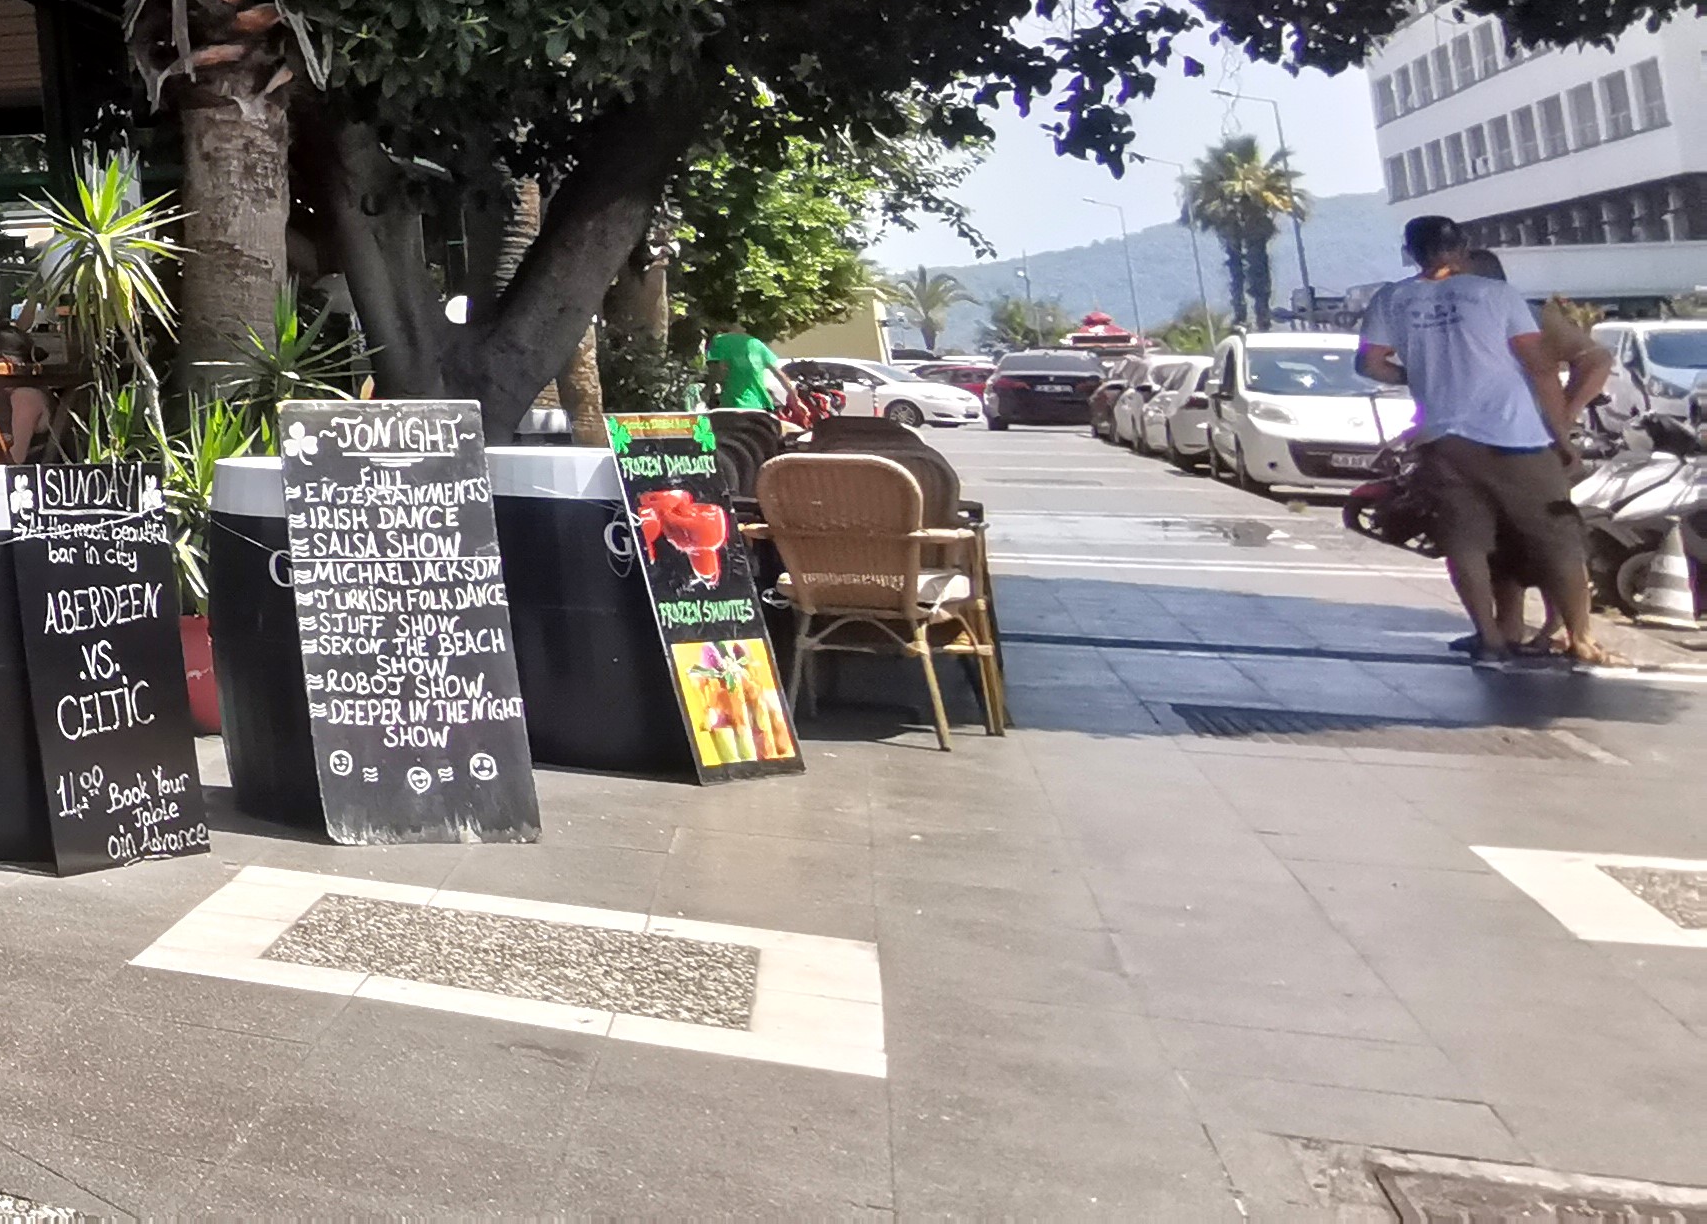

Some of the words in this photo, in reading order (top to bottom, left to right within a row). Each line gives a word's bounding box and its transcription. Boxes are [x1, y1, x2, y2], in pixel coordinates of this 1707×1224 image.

[45, 463, 135, 510] SUNDAY
[357, 466, 411, 490] FULL
[309, 506, 369, 530] IRISH
[377, 506, 460, 530] DANCE
[48, 541, 77, 564] bar
[84, 541, 100, 565] in
[104, 541, 138, 573] city
[313, 531, 381, 559] SALSA
[386, 531, 462, 559] SHOW
[312, 561, 409, 586] MICHAEL
[412, 558, 502, 586] JACKSON
[44, 582, 163, 634] ABERDEEN
[407, 588, 454, 613] FOLK
[454, 583, 509, 610] DANCE
[396, 614, 461, 637] SHOW
[318, 635, 355, 655] SEX
[356, 639, 386, 655] ON
[392, 637, 429, 657] THE
[438, 628, 506, 656] BEACH
[377, 655, 449, 678] SHOW
[57, 675, 155, 741] CELTIC
[328, 699, 407, 726] DEEPER
[408, 699, 430, 723] IN
[432, 699, 469, 724] THE
[384, 726, 450, 749] SHOW
[106, 773, 152, 814] Book
[151, 764, 189, 797] Your
[139, 822, 210, 852] Advance
